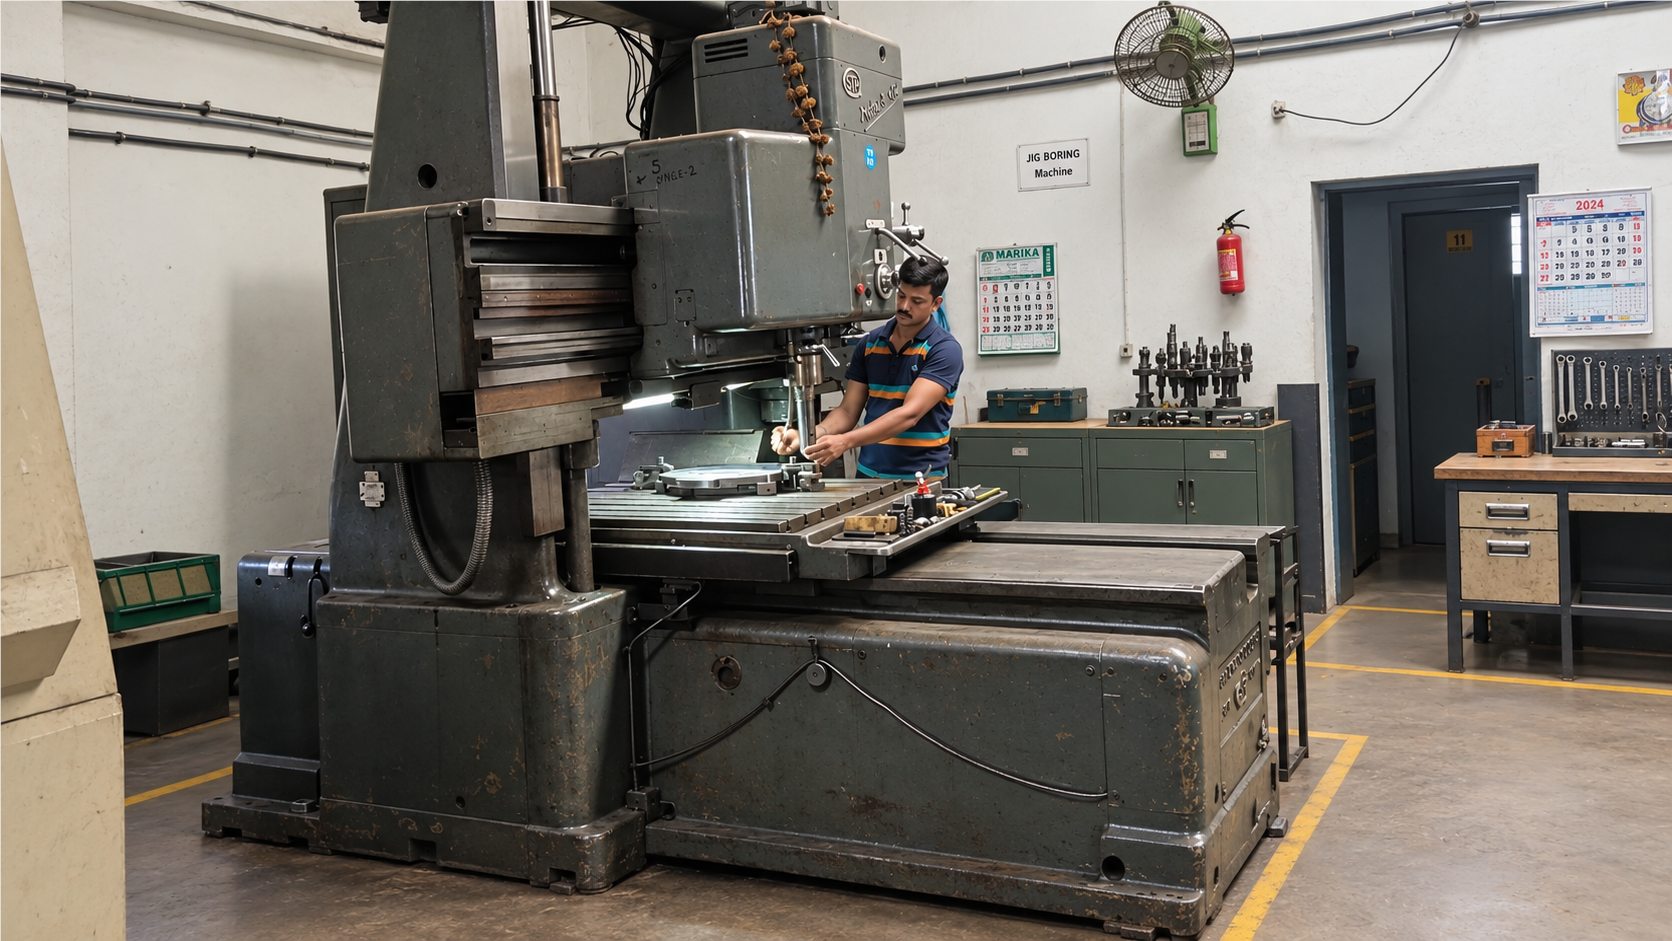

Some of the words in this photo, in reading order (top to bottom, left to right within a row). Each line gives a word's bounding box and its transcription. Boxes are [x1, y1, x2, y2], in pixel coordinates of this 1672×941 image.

[1026, 153, 1041, 163] JIG
[1043, 149, 1080, 161] BORING
[1035, 166, 1073, 178] Machine
[1576, 199, 1604, 211] 2024
[1454, 234, 1465, 245] 11
[996, 247, 1039, 259] MARIKA
